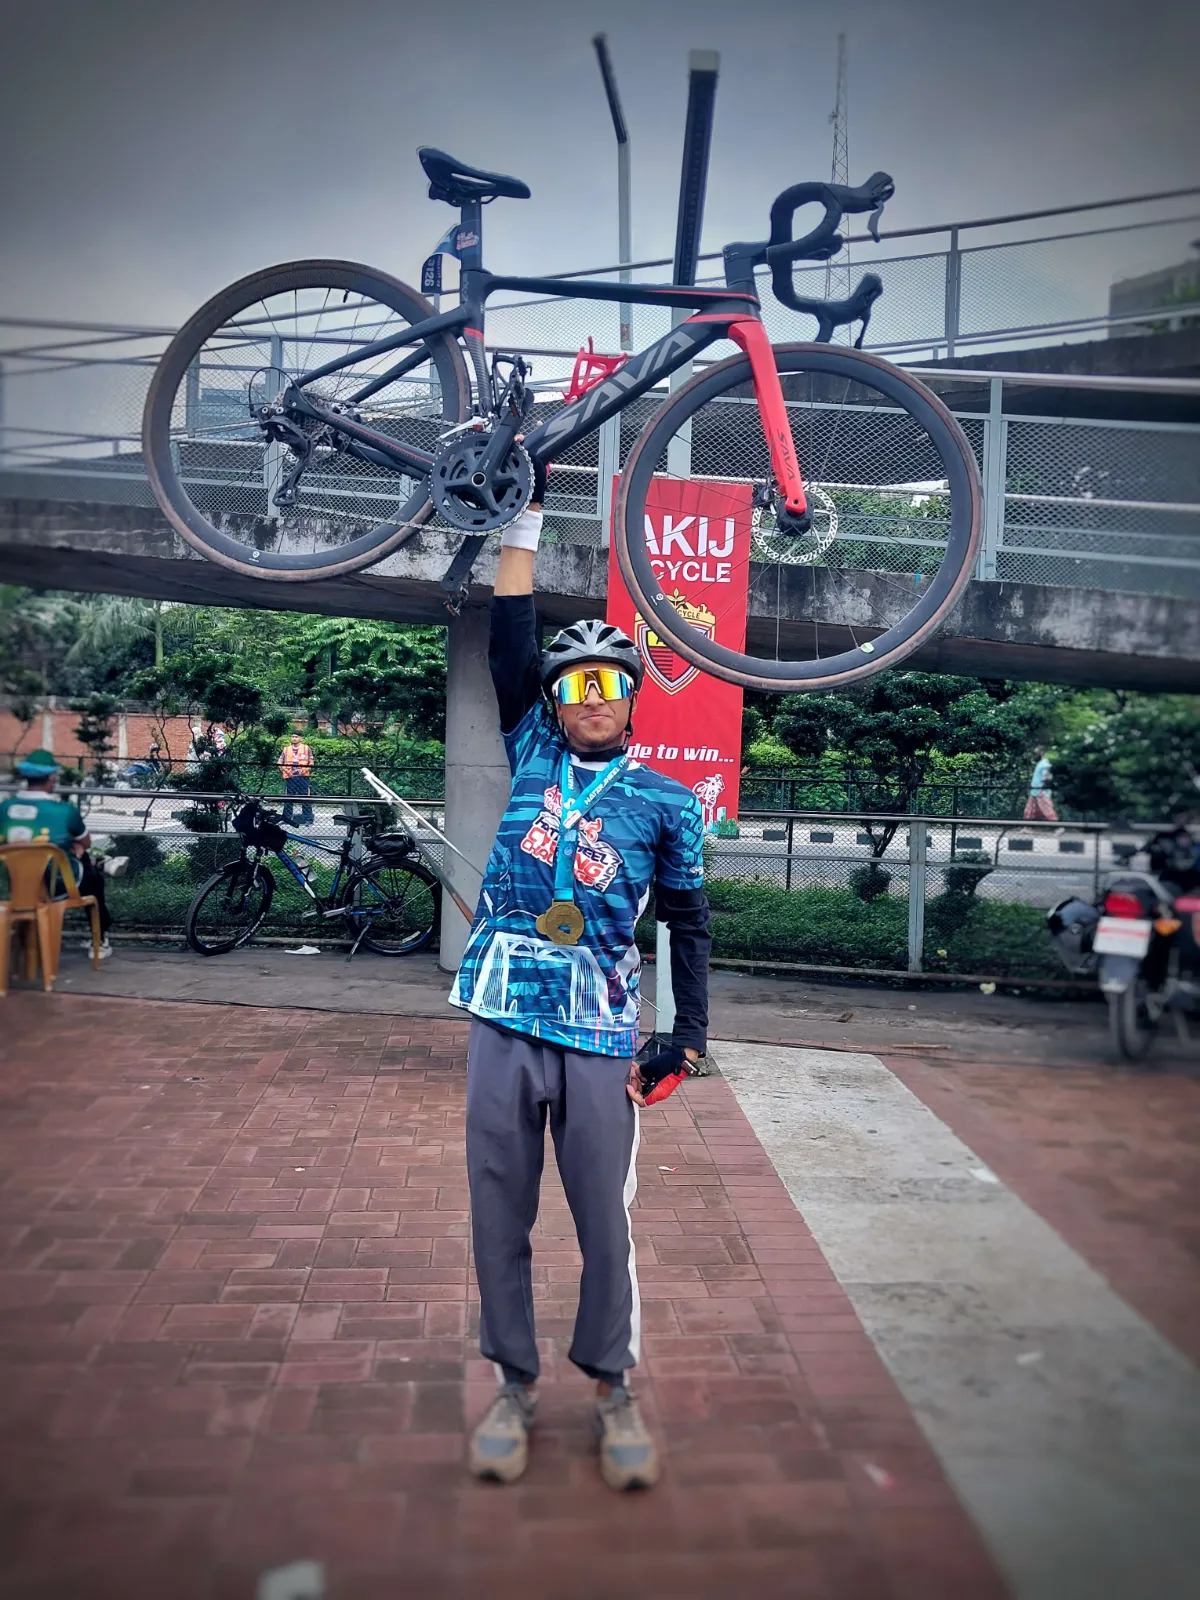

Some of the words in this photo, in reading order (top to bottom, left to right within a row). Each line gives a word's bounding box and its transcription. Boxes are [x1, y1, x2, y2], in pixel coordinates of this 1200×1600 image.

[537, 331, 696, 455] SAVA
[777, 427, 796, 481] SAVA
[650, 559, 732, 583] CYCLE
[677, 609, 701, 620] CYCLE
[627, 743, 653, 759] de
[656, 744, 679, 760] to
[683, 746, 734, 763] win...
